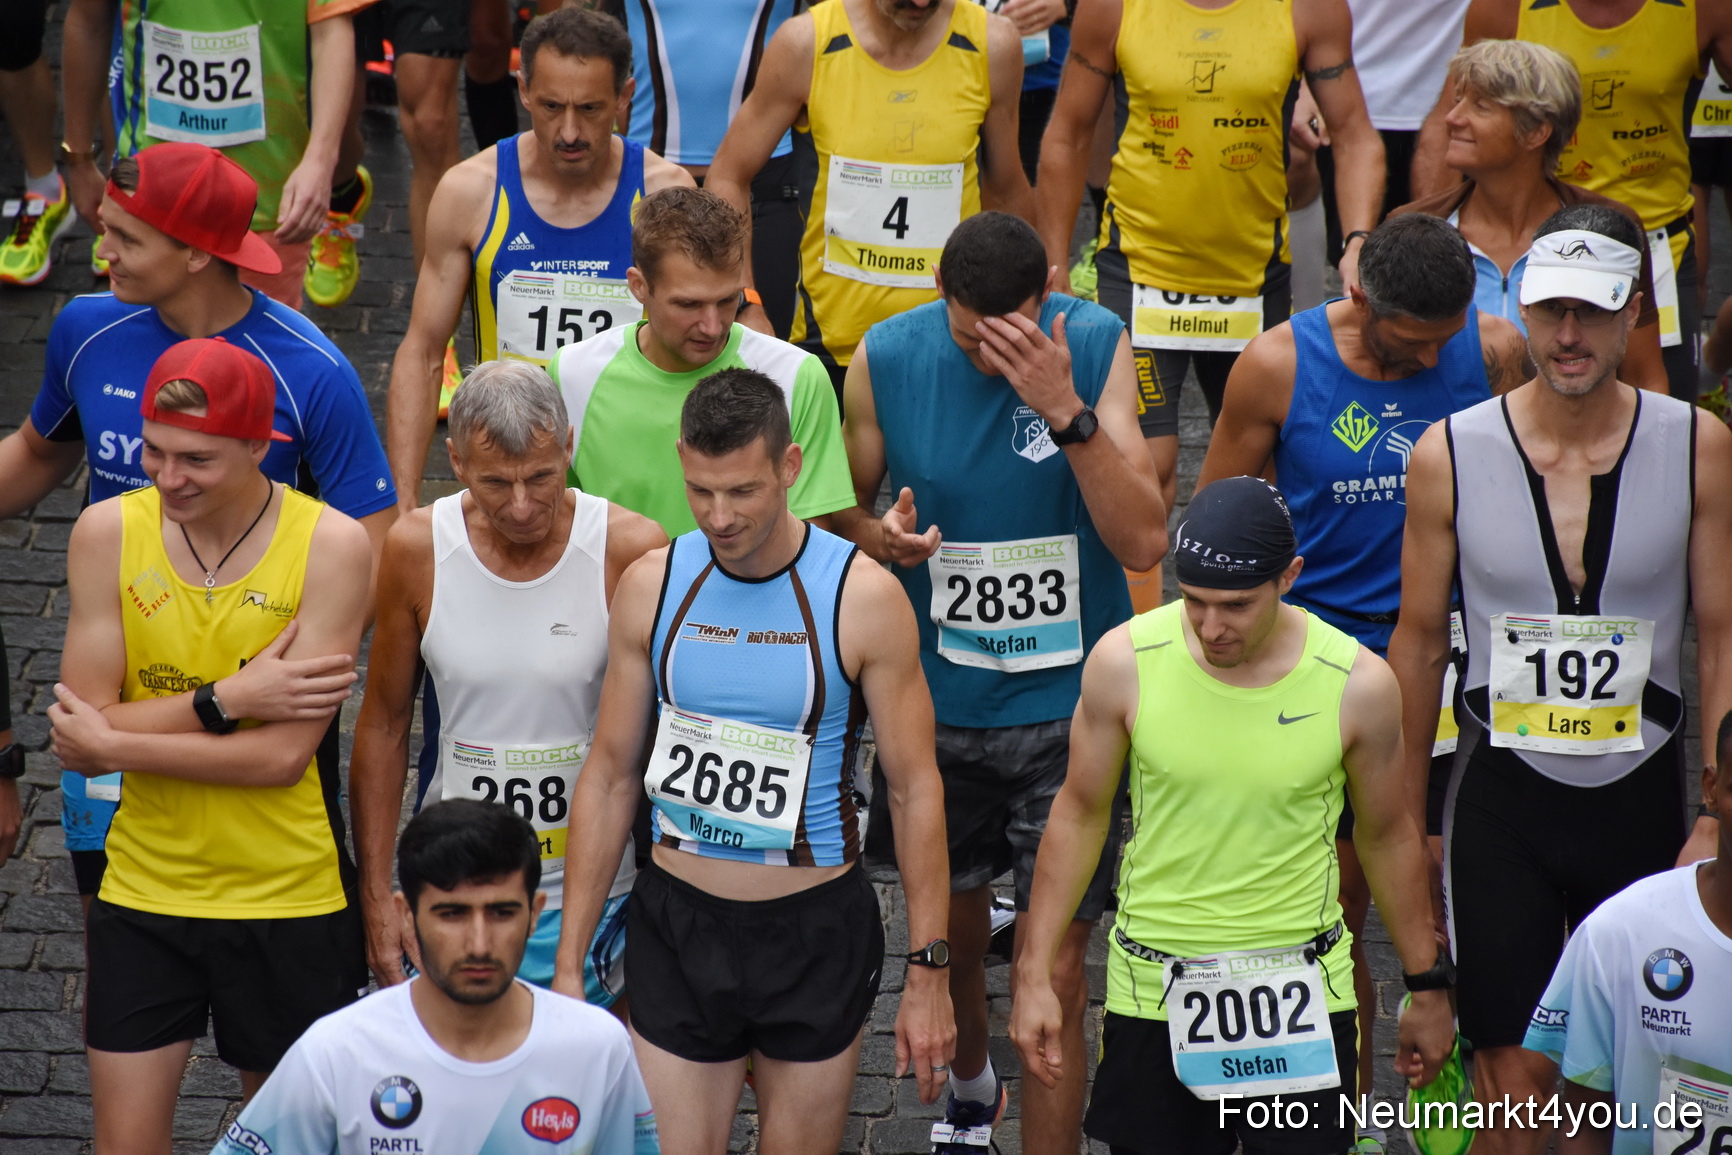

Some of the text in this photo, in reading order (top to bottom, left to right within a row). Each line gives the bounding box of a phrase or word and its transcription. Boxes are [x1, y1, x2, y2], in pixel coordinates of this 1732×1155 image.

[191, 32, 249, 50] BOCK
[156, 53, 252, 103] 2852
[179, 111, 228, 131] Arthur
[1149, 113, 1179, 129] Seidl
[1220, 141, 1263, 157] PIZZERIA
[839, 172, 883, 184] NeuerMarkt
[891, 169, 953, 184] BOCK
[882, 196, 909, 240] 4
[508, 243, 535, 251] adidas
[543, 260, 610, 271] INTERSPORT
[857, 248, 925, 271] Thomas
[510, 285, 555, 296] NeuerMarkt
[563, 280, 631, 299] BOCK
[1170, 315, 1229, 334] Helmut
[503, 342, 509, 351] A
[113, 387, 136, 399] JAKO
[1024, 418, 1045, 446] TSV
[98, 430, 144, 465] SY
[94, 467, 154, 487] www.me
[1332, 473, 1407, 495] GRAM
[1334, 490, 1394, 504] SOLAR
[939, 556, 984, 566] NeuerMarkt
[992, 541, 1065, 563] BOCK
[151, 591, 171, 611] BECK
[946, 569, 1067, 623] 2833
[1504, 627, 1553, 638] NeuerMarkt
[1562, 620, 1638, 636] BOCK
[778, 632, 807, 645] RACER
[977, 635, 1037, 655] Stefan
[1525, 648, 1620, 700] 192
[1497, 692, 1504, 701] A
[669, 721, 713, 740] NeuerMarkt
[1548, 713, 1591, 735] Lars
[720, 724, 797, 755] BOCK
[452, 752, 497, 767] NeuerMarkt
[505, 743, 582, 766] BOCK
[660, 744, 790, 819] 2685
[651, 788, 657, 796] A
[689, 813, 744, 848] Marco
[1229, 952, 1304, 975] BOCK
[1648, 949, 1690, 969] BMW
[1175, 970, 1221, 981] NeuerMarkt
[1183, 980, 1316, 1044] 2002
[1641, 1006, 1692, 1026] PARTL
[1641, 1019, 1692, 1036] Neumarkt
[1178, 1042, 1185, 1051] A
[1221, 1056, 1288, 1079] Stefan
[376, 1076, 418, 1096] BMW
[370, 1137, 424, 1153] PARTL
